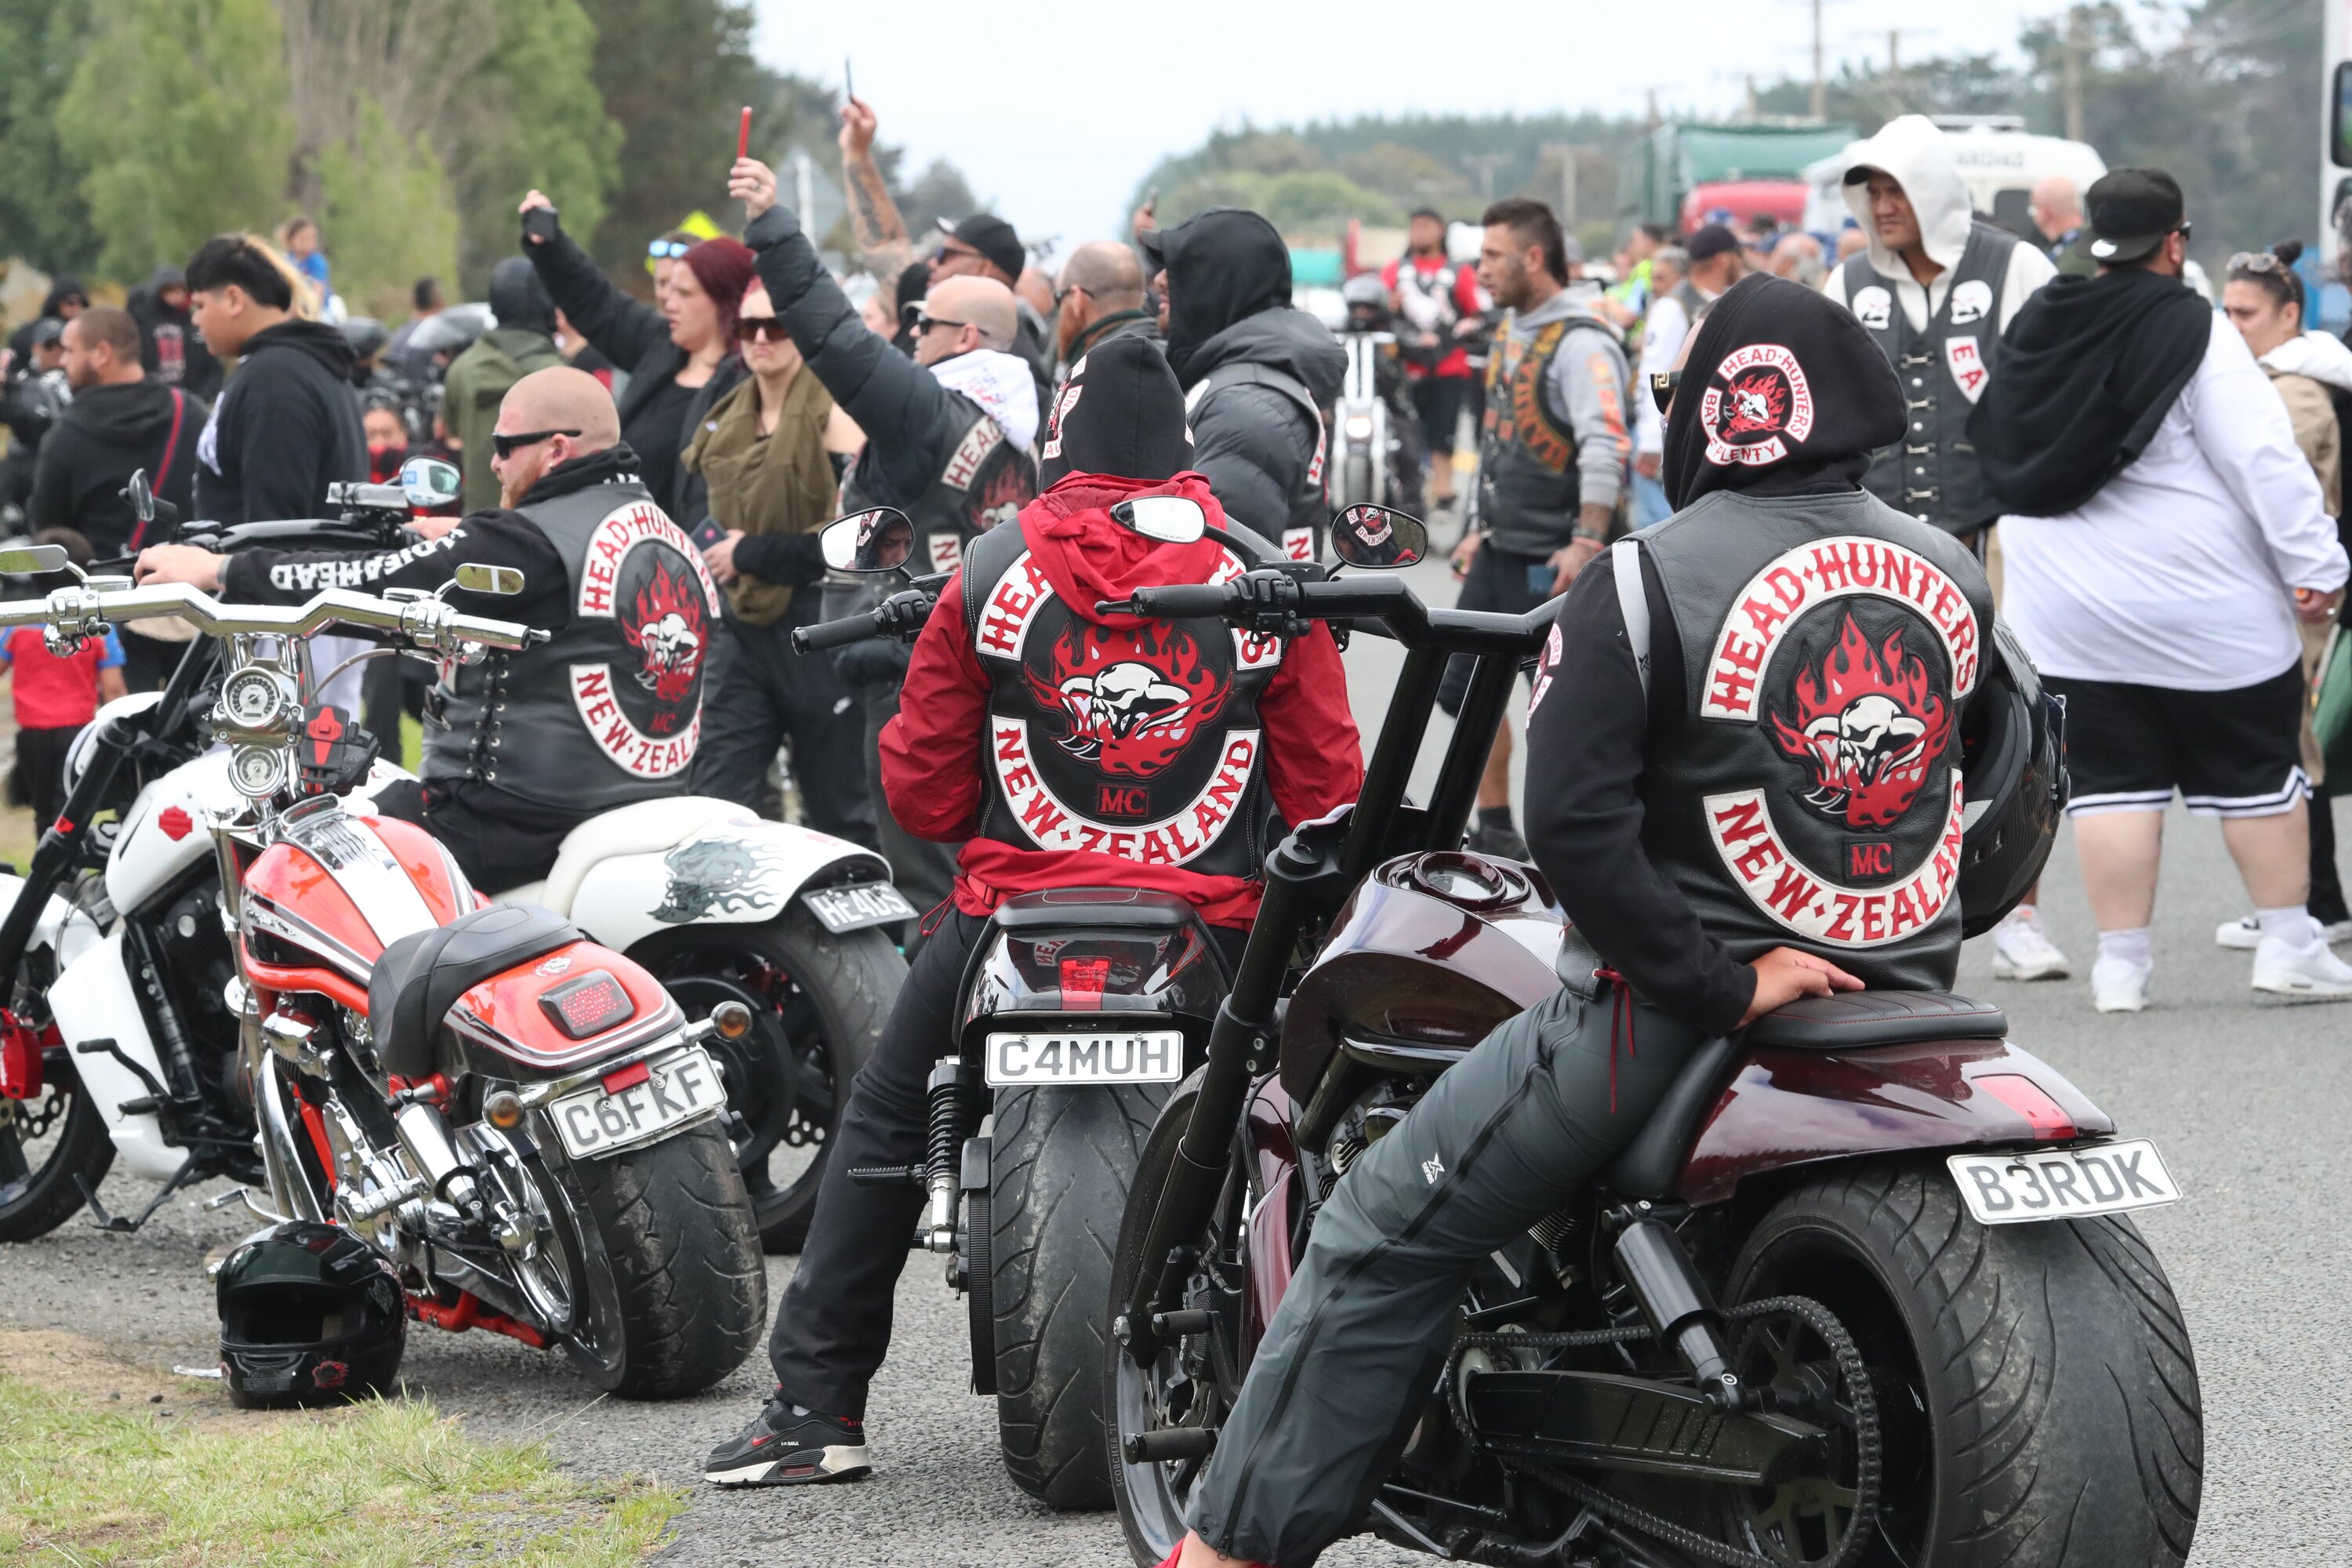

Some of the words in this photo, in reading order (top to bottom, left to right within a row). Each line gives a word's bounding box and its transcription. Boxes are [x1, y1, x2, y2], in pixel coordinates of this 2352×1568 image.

[1704, 394, 1719, 426] BAY
[1714, 442, 1777, 463] PLENTY
[982, 557, 1044, 655] HEA
[631, 709, 703, 773] ZEALA
[650, 711, 677, 734] MC
[1101, 789, 1147, 815] MC
[1850, 844, 1894, 877] MC
[999, 1038, 1169, 1076] C4MUH
[564, 1060, 703, 1146] C6FKF
[1421, 1161, 1435, 1185] series
[1965, 1149, 2166, 1212] B3RDK
[1109, 1436, 1125, 1487] SCORCHER
